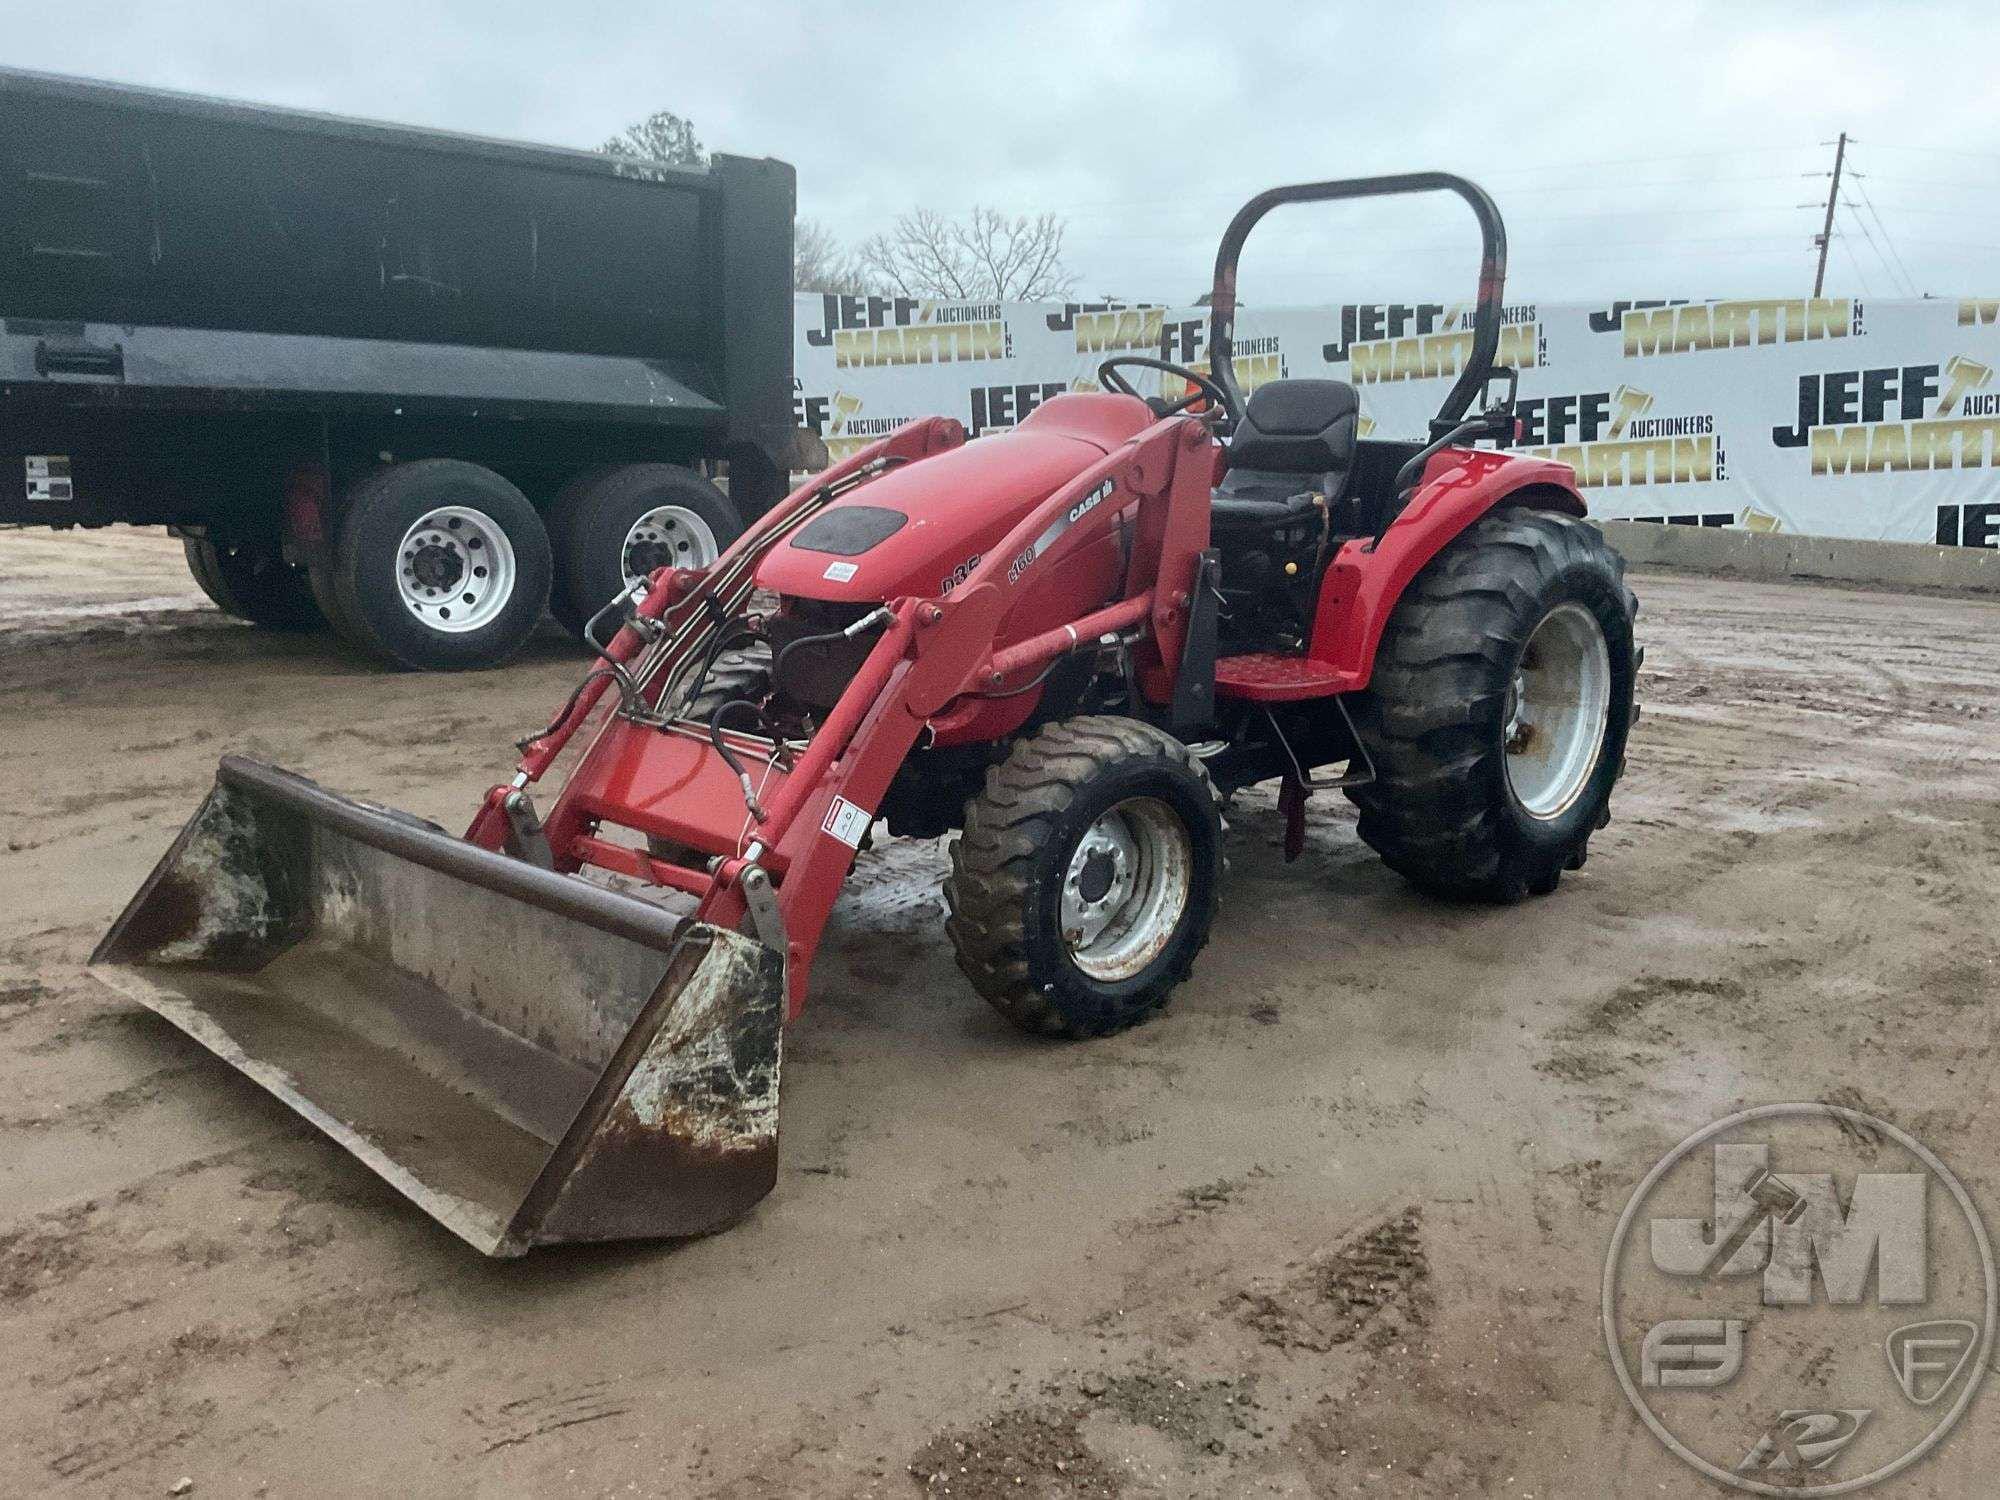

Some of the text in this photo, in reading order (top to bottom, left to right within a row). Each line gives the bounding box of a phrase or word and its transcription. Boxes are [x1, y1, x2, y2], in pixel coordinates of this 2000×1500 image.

[935, 304, 1001, 324] AUCTIONEERS
[1623, 299, 1848, 358] MARTIN
[835, 321, 1002, 369] MARTIN
[1516, 393, 1610, 447] EFF
[1630, 414, 1713, 439] AUCTIONEERS
[1772, 364, 1939, 448] JEFF
[1525, 436, 1712, 488] ARTIN
[1069, 489, 1101, 522] CASE
